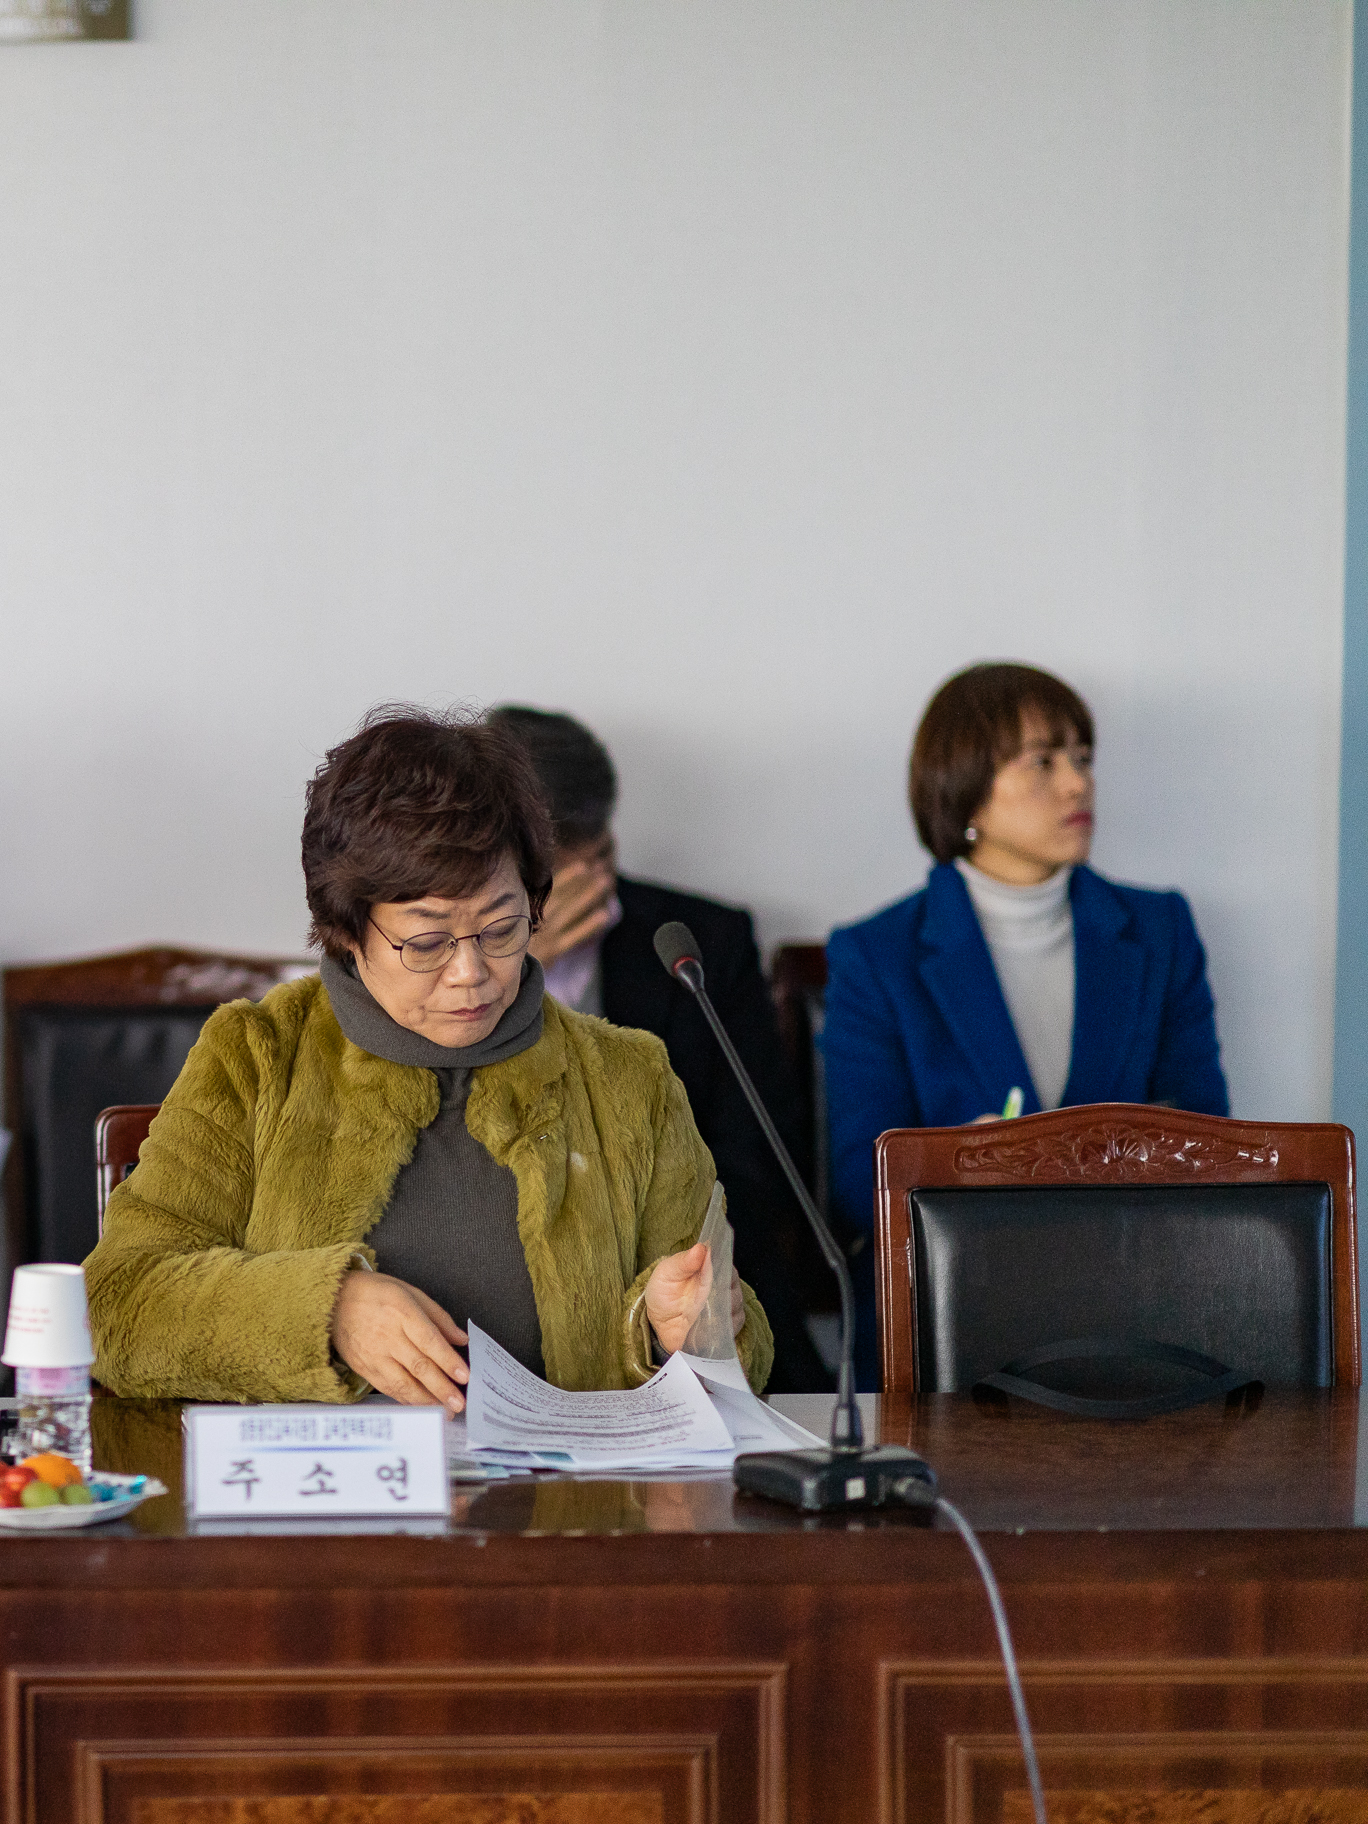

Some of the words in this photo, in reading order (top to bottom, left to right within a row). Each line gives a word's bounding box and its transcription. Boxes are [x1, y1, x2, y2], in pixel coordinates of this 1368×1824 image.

[221, 1458, 261, 1502] 주
[297, 1461, 338, 1497] 소
[376, 1456, 410, 1502] 연
